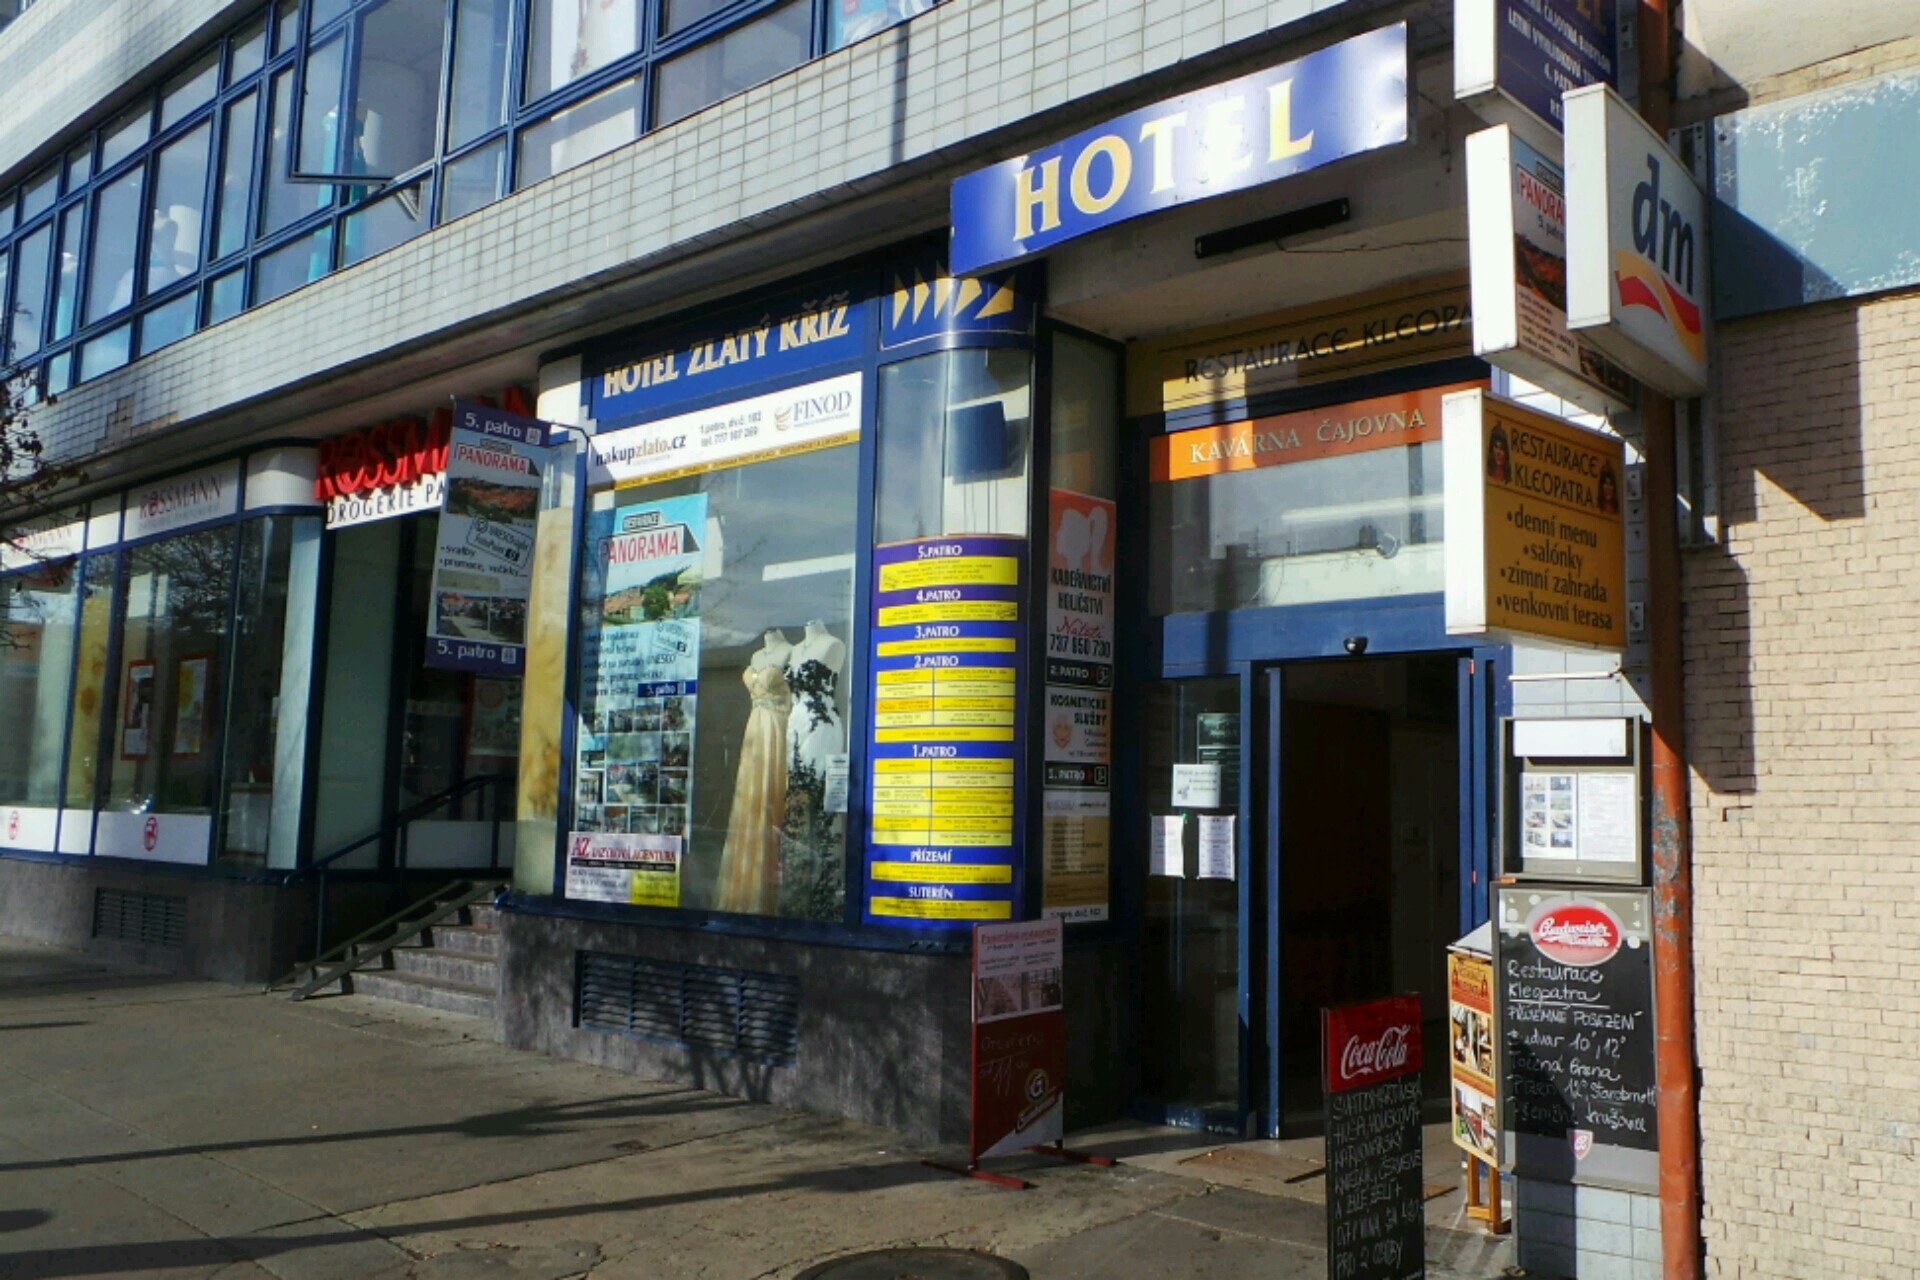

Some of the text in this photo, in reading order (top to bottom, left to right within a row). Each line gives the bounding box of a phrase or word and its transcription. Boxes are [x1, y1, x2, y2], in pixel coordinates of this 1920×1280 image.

[1012, 78, 1314, 242] HOTEL
[1631, 152, 1694, 296] dm
[602, 289, 851, 399] HOTEL ZLATÝ KŘÍŽ
[1184, 326, 1349, 384] RESTAURACE
[792, 390, 853, 422] FINOD
[465, 411, 521, 439] 5. patro
[1188, 408, 1426, 463] KAVÁRNA ČAJOVNA
[456, 444, 527, 475] PANORAMA
[595, 434, 687, 467] nakupzlato.cz
[1510, 427, 1600, 479] RESTAURACE
[1513, 462, 1599, 508] KLEOPATRA
[326, 487, 417, 525] DROGERIE
[1513, 503, 1598, 549] denní menu
[600, 529, 679, 566] PANORAMA
[1530, 543, 1583, 575] salónky
[1507, 559, 1607, 603] zimní zahrada
[1503, 590, 1613, 630] venkovní terasa
[437, 639, 496, 661] 5. patro
[910, 847, 953, 862] PŘÍZEMÍ
[908, 884, 954, 899] SUTERÉN
[1506, 960, 1604, 986] Restaurace
[1507, 981, 1601, 1008] Kleopatra
